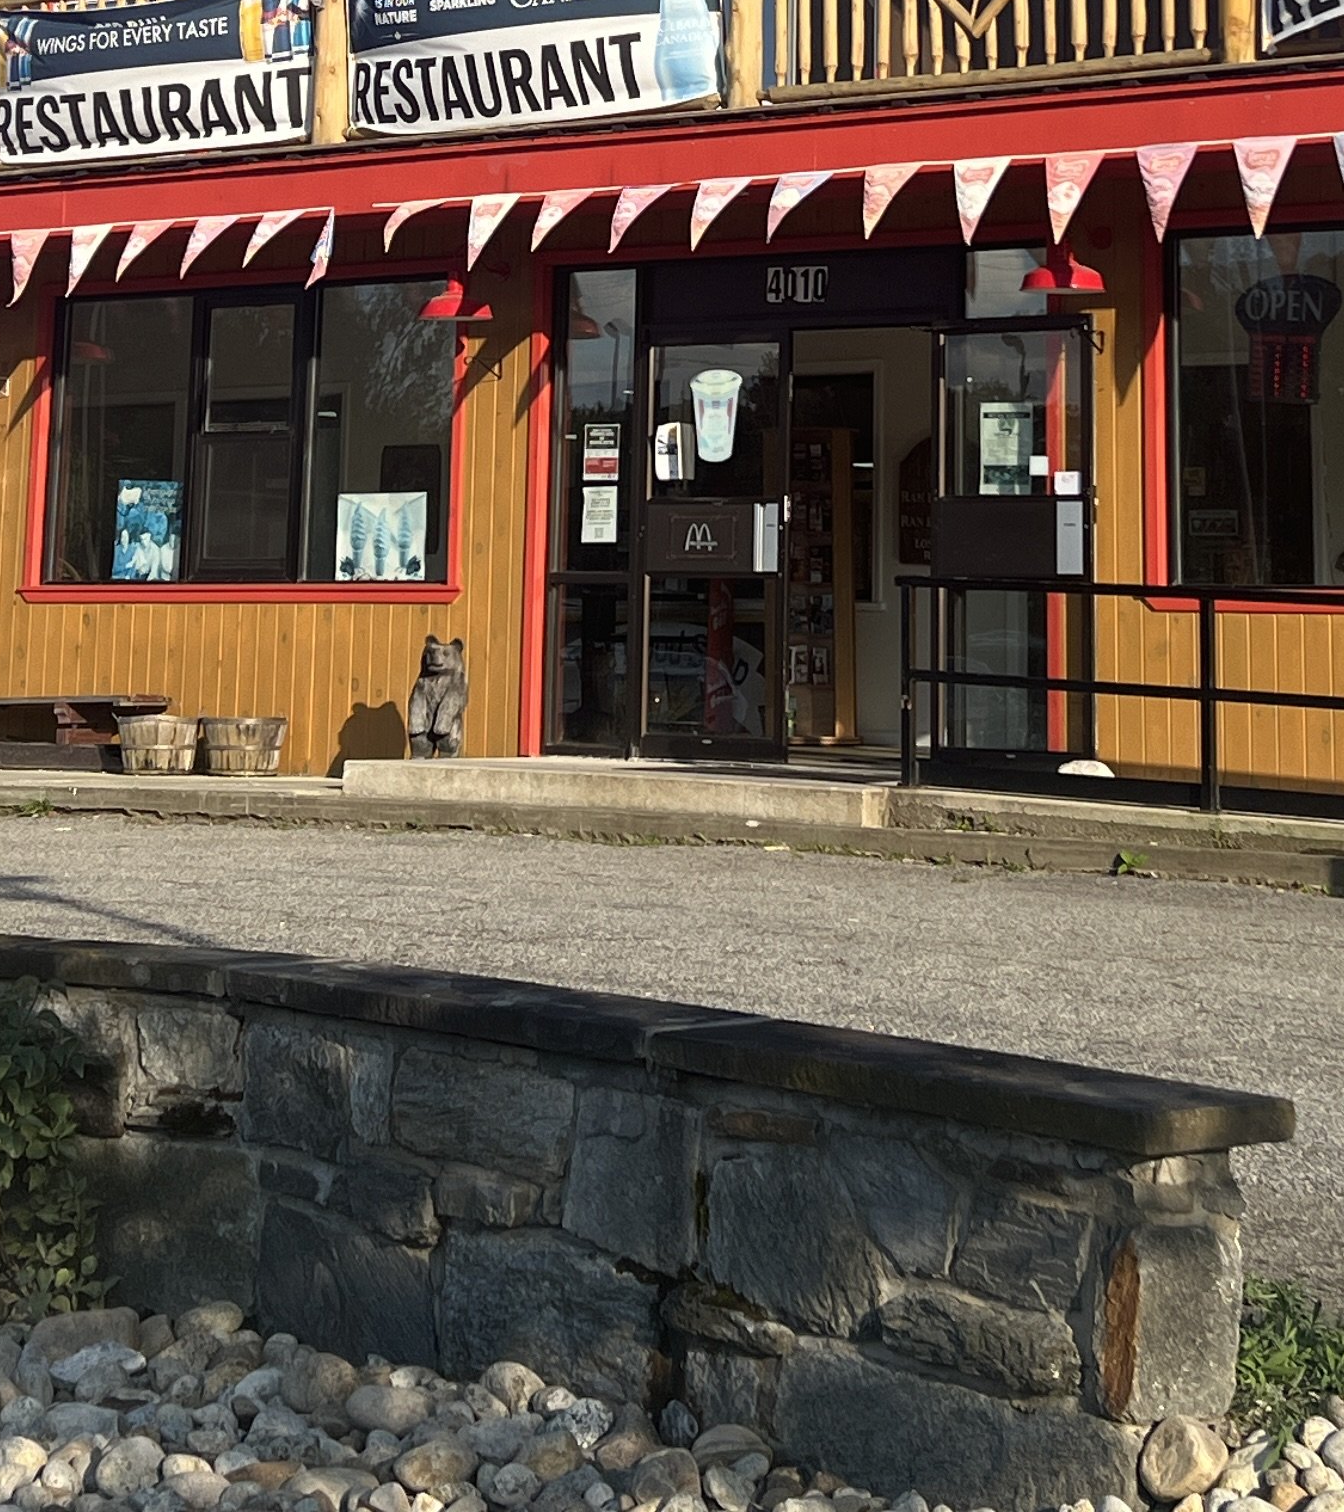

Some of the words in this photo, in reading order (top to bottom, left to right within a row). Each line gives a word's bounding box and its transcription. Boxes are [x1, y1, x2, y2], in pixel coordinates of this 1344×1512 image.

[374, 9, 417, 26] NATURE
[36, 34, 86, 56] WINGS
[89, 30, 119, 50] FOR
[123, 23, 173, 47] EVERY
[176, 16, 230, 42] TASTE
[354, 31, 641, 125] RESTAURANT
[767, 267, 828, 302] 4010
[1244, 288, 1324, 322] OPEN
